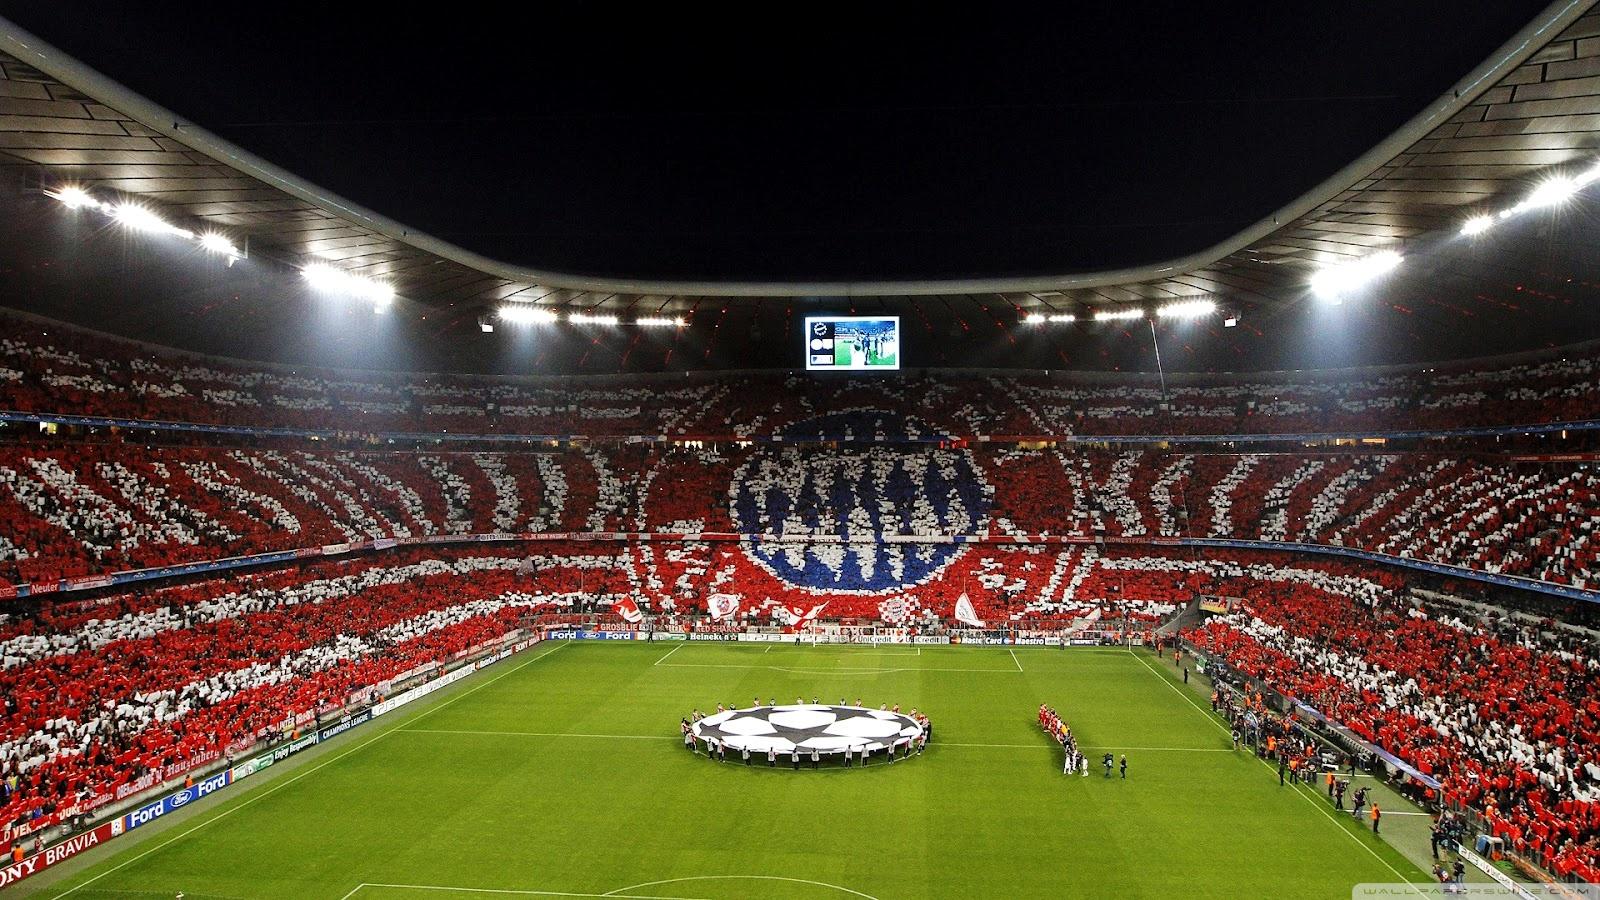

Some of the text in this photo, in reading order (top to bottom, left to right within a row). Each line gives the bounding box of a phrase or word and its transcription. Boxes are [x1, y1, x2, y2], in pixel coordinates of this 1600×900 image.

[551, 631, 577, 639] Ford
[605, 631, 631, 639] Ford
[961, 637, 1003, 645] MasteCard
[1015, 637, 1044, 645] Maestro
[323, 713, 369, 739] CHAMPIONS LEAGUE
[274, 746, 290, 760] Enjoy
[198, 773, 226, 797] Ford
[130, 800, 164, 828] Ford
[45, 831, 98, 866] BRAVIA
